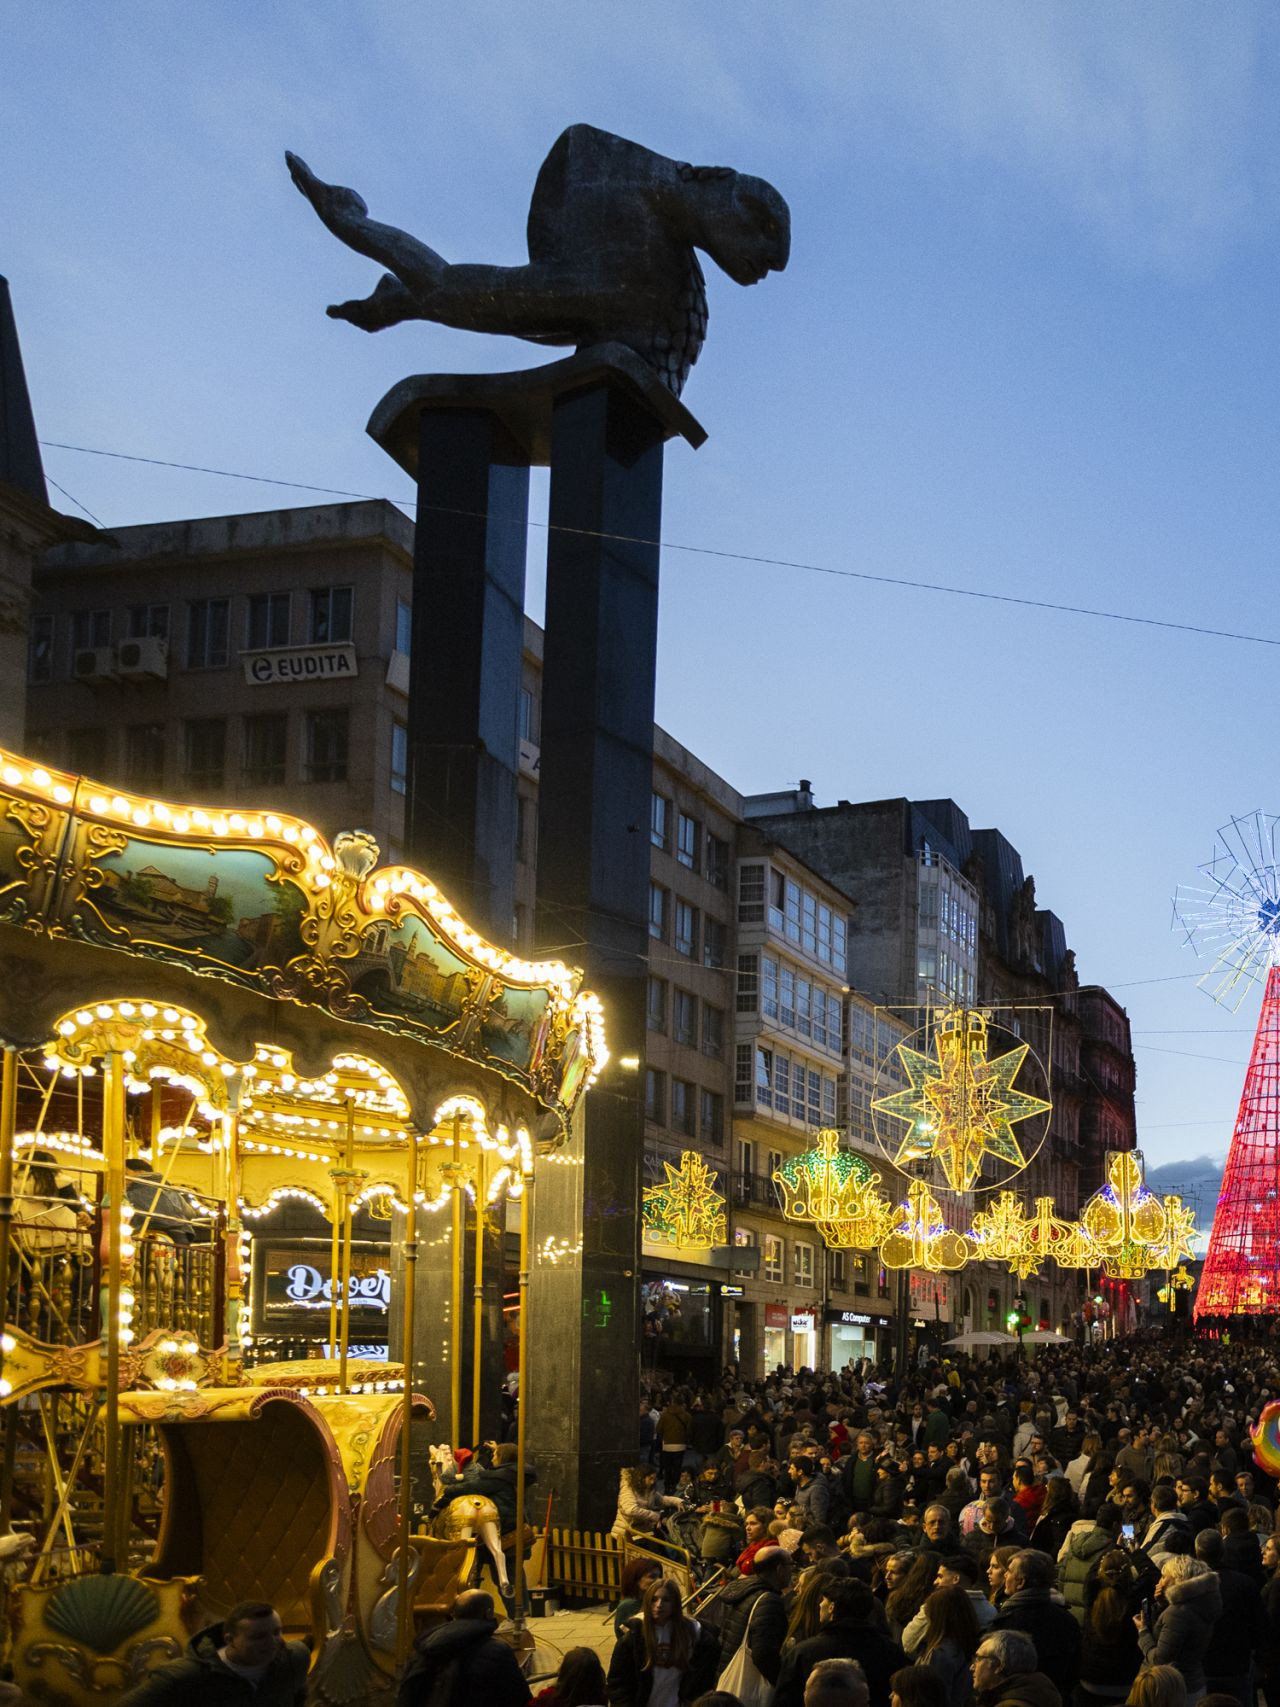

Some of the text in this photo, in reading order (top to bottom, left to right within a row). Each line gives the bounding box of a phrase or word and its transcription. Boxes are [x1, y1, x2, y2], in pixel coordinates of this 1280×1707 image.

[278, 654, 350, 676] EUDITA
[842, 1311, 849, 1321] AS
[850, 1312, 871, 1324] Computer
